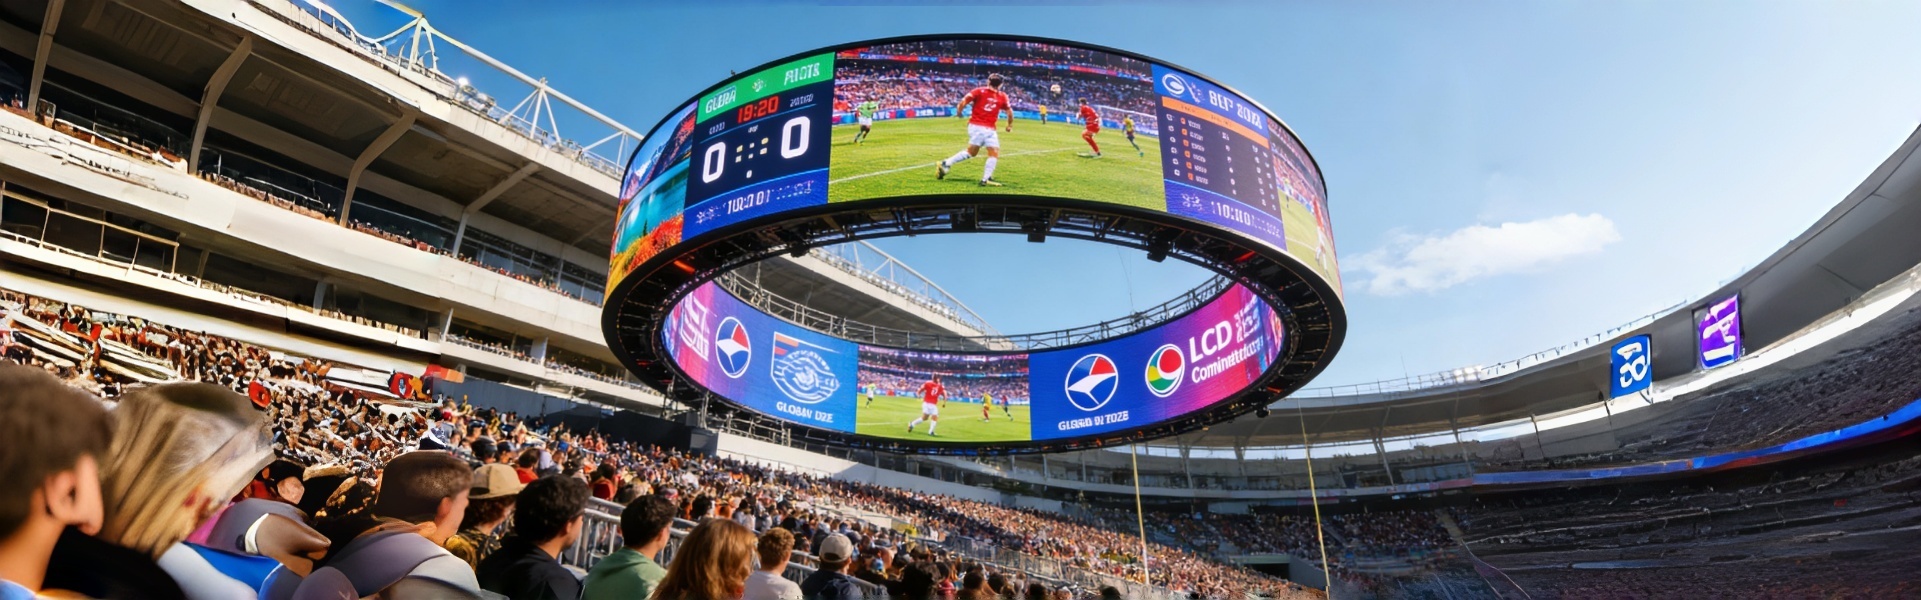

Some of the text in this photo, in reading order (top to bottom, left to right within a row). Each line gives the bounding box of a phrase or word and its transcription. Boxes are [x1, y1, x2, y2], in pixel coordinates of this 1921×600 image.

[702, 115, 811, 184] 0 0
[1188, 320, 1233, 364] LCD
